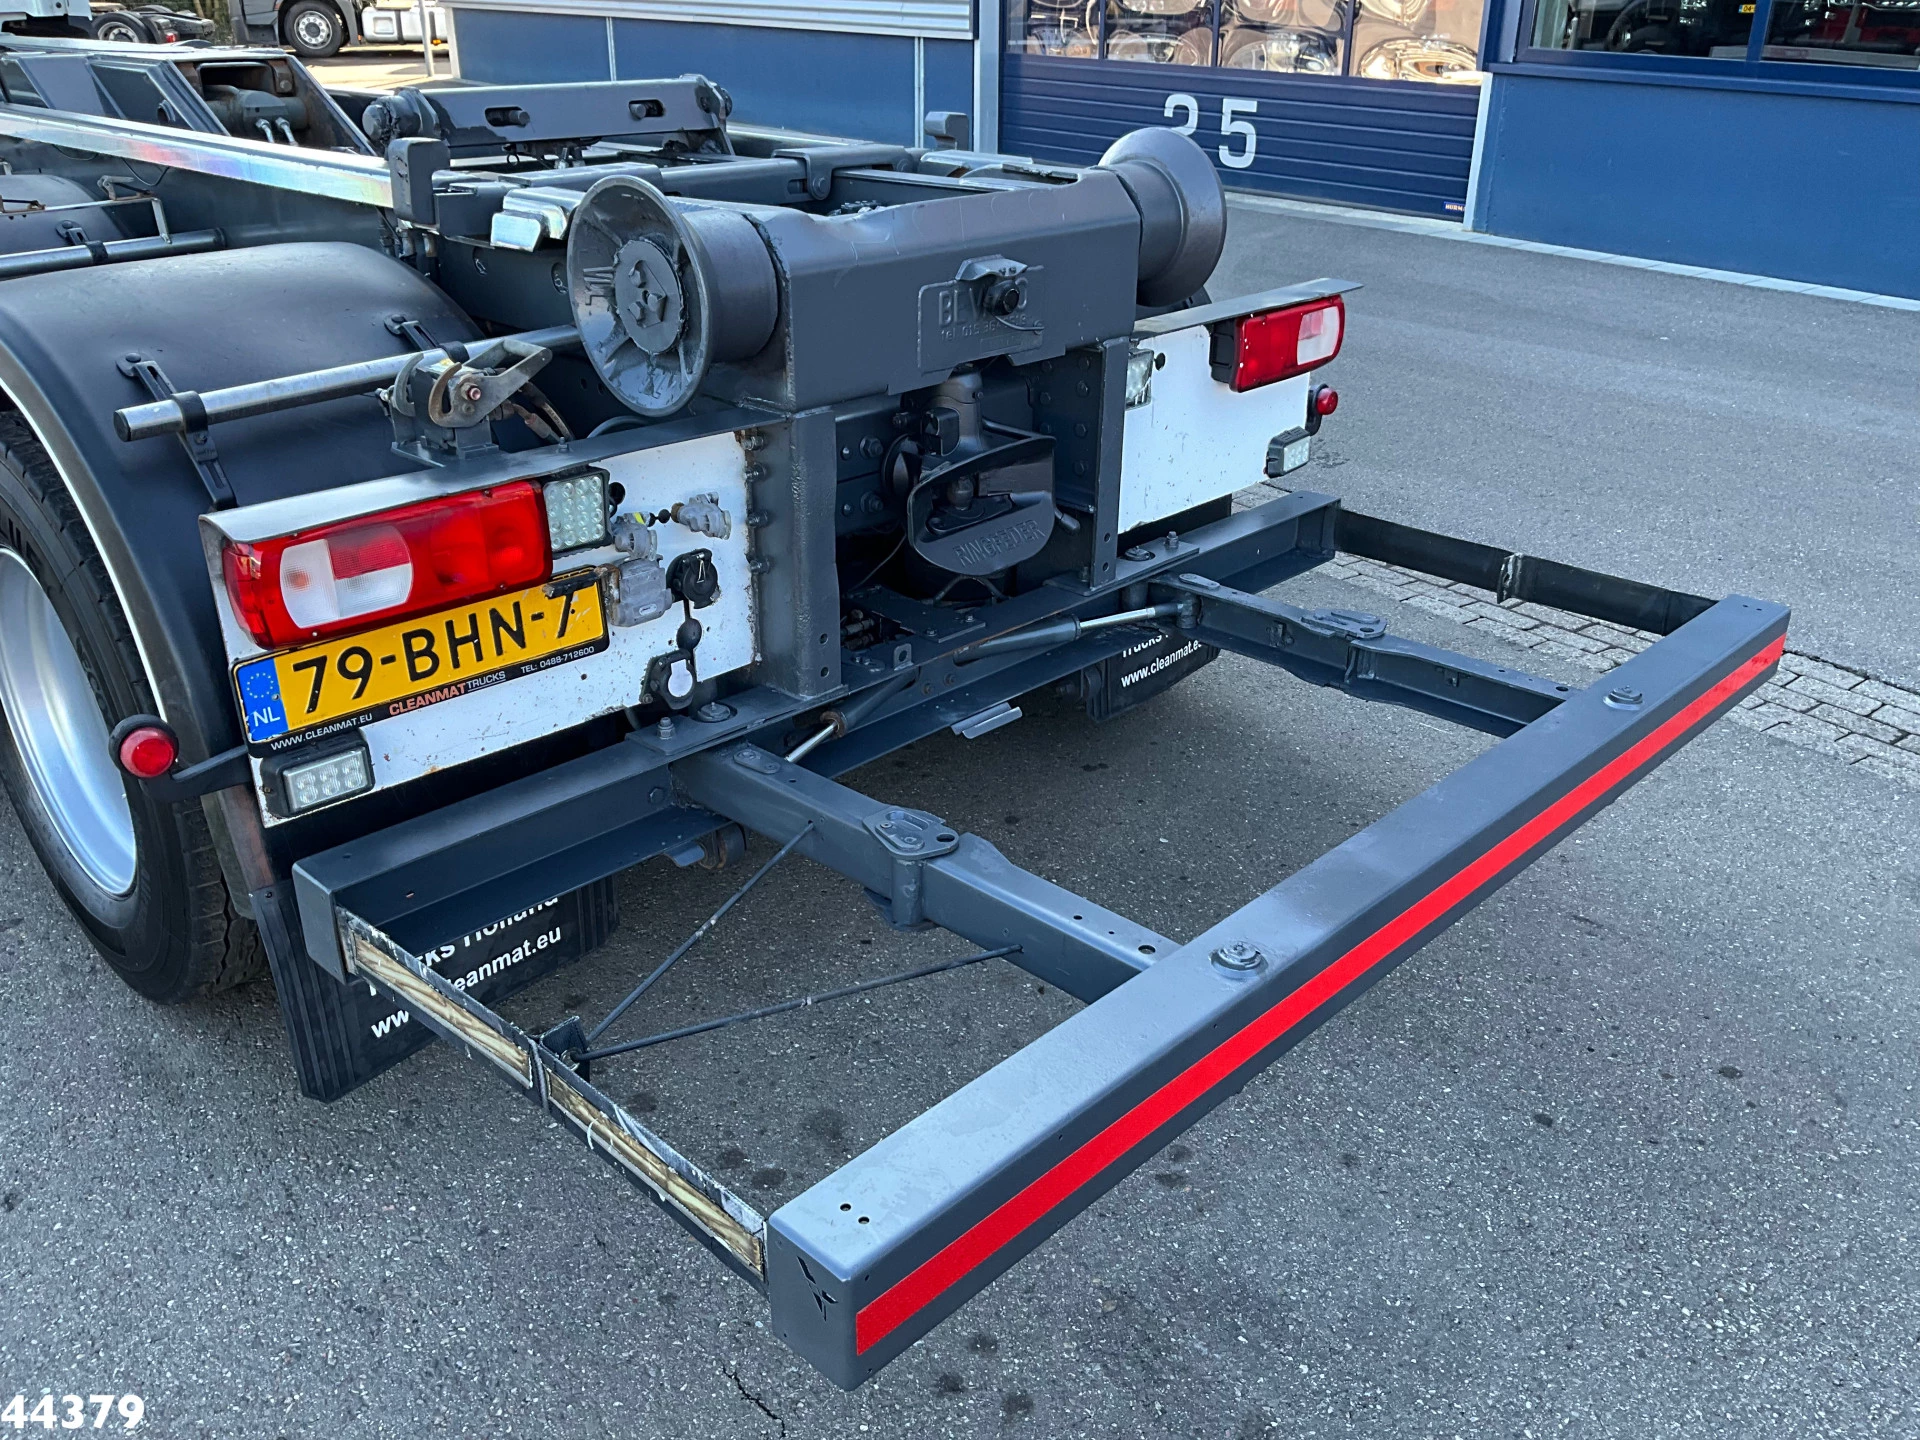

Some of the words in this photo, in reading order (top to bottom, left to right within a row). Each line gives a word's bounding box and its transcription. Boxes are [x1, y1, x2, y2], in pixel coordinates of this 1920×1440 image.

[1164, 94, 1257, 168] 25
[292, 586, 577, 714] 79-BHN-7
[253, 706, 281, 727] NL
[270, 713, 373, 751] WWW.CLEANMAT.EU
[521, 663, 538, 674] TEL:
[540, 645, 595, 669] 0488-712600
